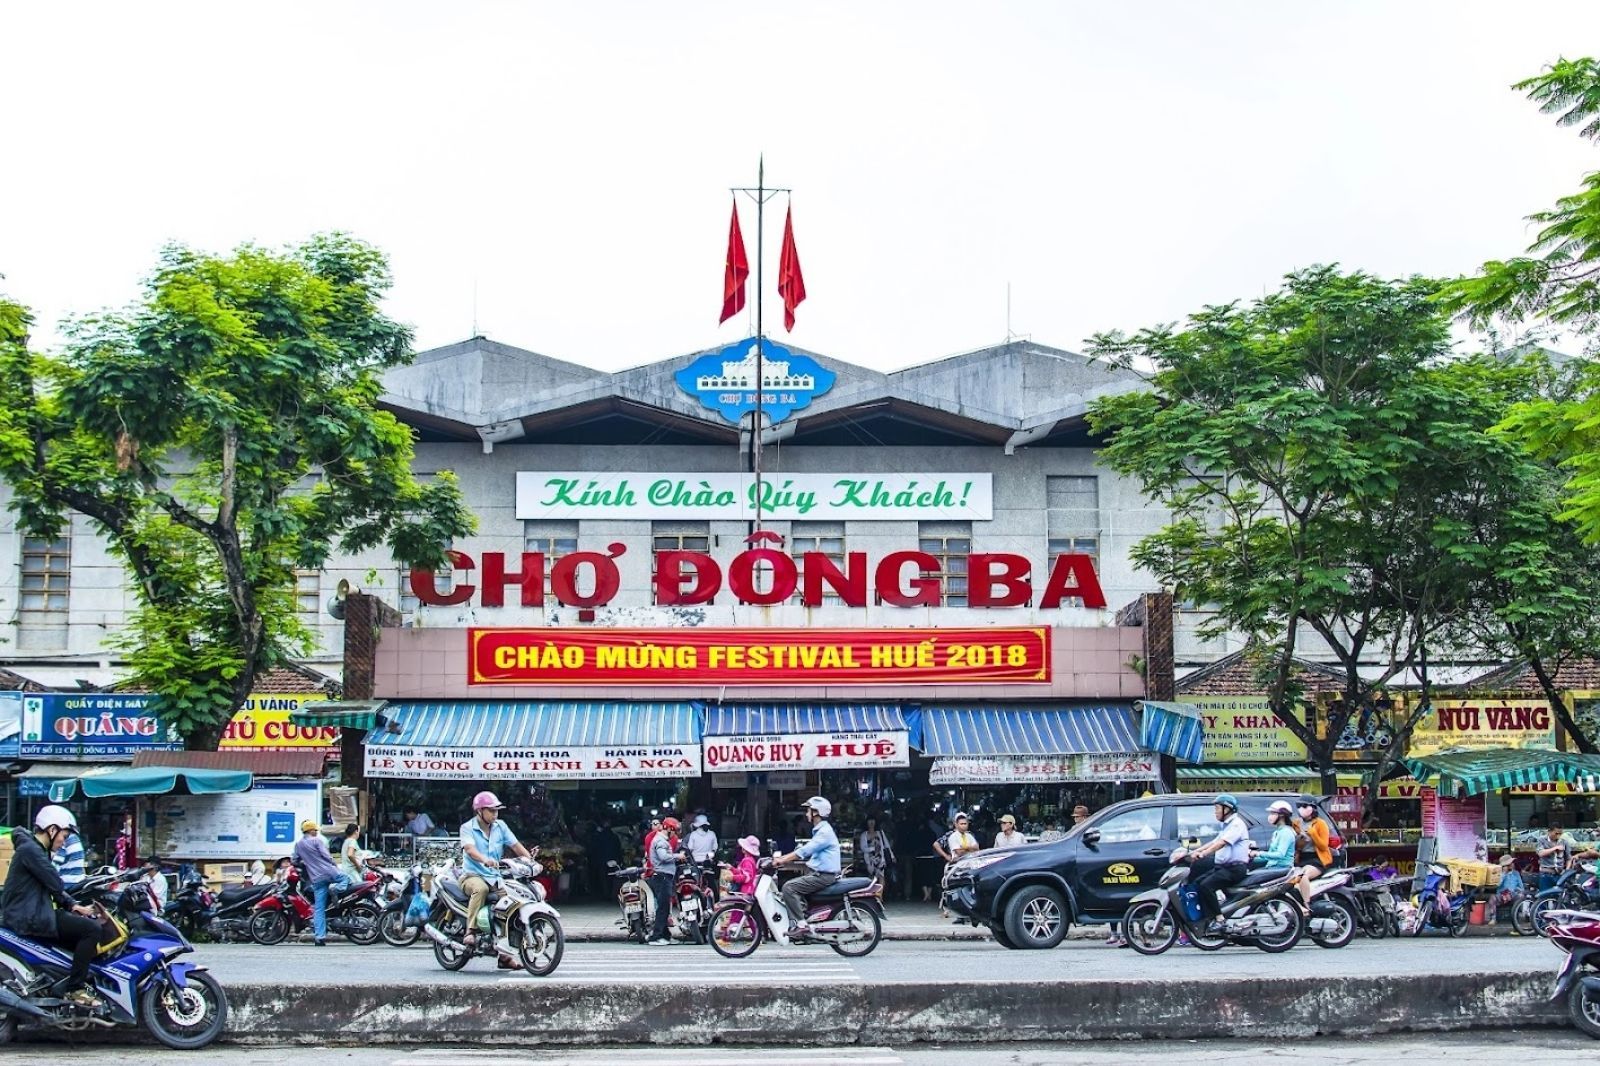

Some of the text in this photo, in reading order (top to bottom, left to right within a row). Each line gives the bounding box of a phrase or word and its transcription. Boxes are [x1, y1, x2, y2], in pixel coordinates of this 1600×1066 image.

[780, 394, 797, 404] BA
[540, 478, 638, 508] Kính
[647, 480, 737, 508] Chào
[829, 479, 974, 508] Khách!
[409, 531, 1108, 622] CHỢ ĐÔNG BA
[494, 637, 1028, 669] CHÀO MỪNG FESTIVAL HUẾ 2018
[260, 697, 299, 711] VÀNG
[1233, 715, 1287, 729] KHAN
[1437, 700, 1550, 731] NÚI VÀNG
[219, 715, 256, 740] HÚ
[107, 746, 118, 754] BA
[707, 743, 805, 767] QUANG HUY
[816, 739, 897, 760] HUỆ
[371, 757, 471, 771] LÊ VƯƠNG
[482, 759, 582, 773] CHỊ TÌNH
[595, 757, 693, 769] BÀ NGA
[1102, 876, 1119, 884] TAXI
